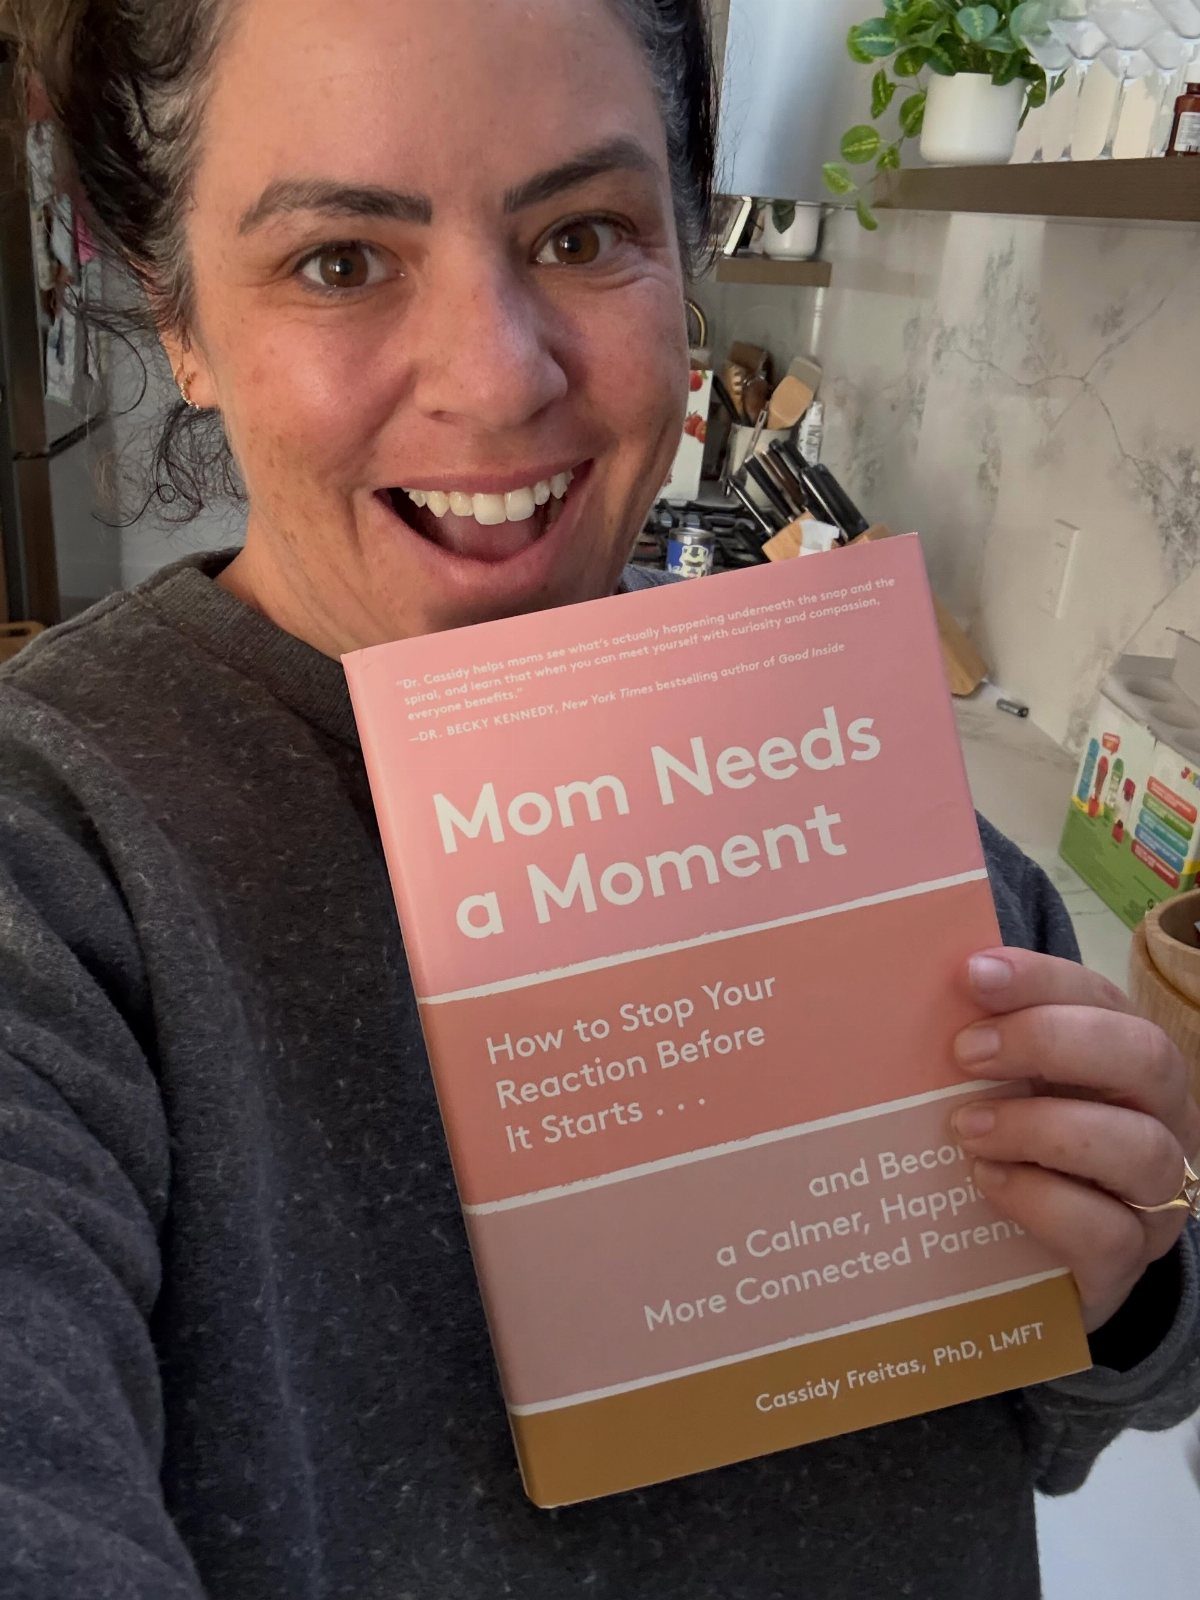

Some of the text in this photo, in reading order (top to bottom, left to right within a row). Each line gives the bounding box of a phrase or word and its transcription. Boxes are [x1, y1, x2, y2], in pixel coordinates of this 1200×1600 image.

[404, 597, 880, 706] spiral, and learn that when you can meet yourself with curiosity and compassion,
[424, 668, 470, 685] Cassidy
[473, 661, 504, 675] helps
[508, 653, 543, 667] moms
[546, 647, 565, 659] see
[568, 638, 609, 655] what's
[612, 628, 659, 645] actually
[663, 613, 725, 634] happening
[727, 599, 795, 620] underneath
[798, 594, 817, 606] the
[820, 588, 848, 602] snap
[851, 581, 872, 594] and
[875, 577, 896, 589] the
[408, 703, 462, 721] everyone
[447, 717, 489, 736] BECKY
[494, 704, 559, 726] KENNEDY,
[562, 699, 588, 712] New
[591, 691, 616, 704] York
[620, 685, 653, 699] Times
[656, 671, 718, 691] bestselling
[720, 662, 760, 677] author
[763, 656, 775, 668] of
[778, 649, 809, 664] Good
[812, 642, 846, 657] Inside
[433, 706, 880, 854] Mom Needs
[456, 805, 847, 938] a Moment
[486, 977, 775, 1064] How to Stop Your
[496, 1026, 765, 1109] Reaction Before
[506, 1125, 533, 1152] It
[541, 1102, 643, 1143] Starts
[809, 1144, 964, 1197] and Beco
[717, 1176, 985, 1266] a Calmer, Happi
[644, 1293, 727, 1331] More
[735, 1240, 912, 1305] Connected
[755, 1322, 1044, 1412] Cassidy Freitas, PhD, LMFT
